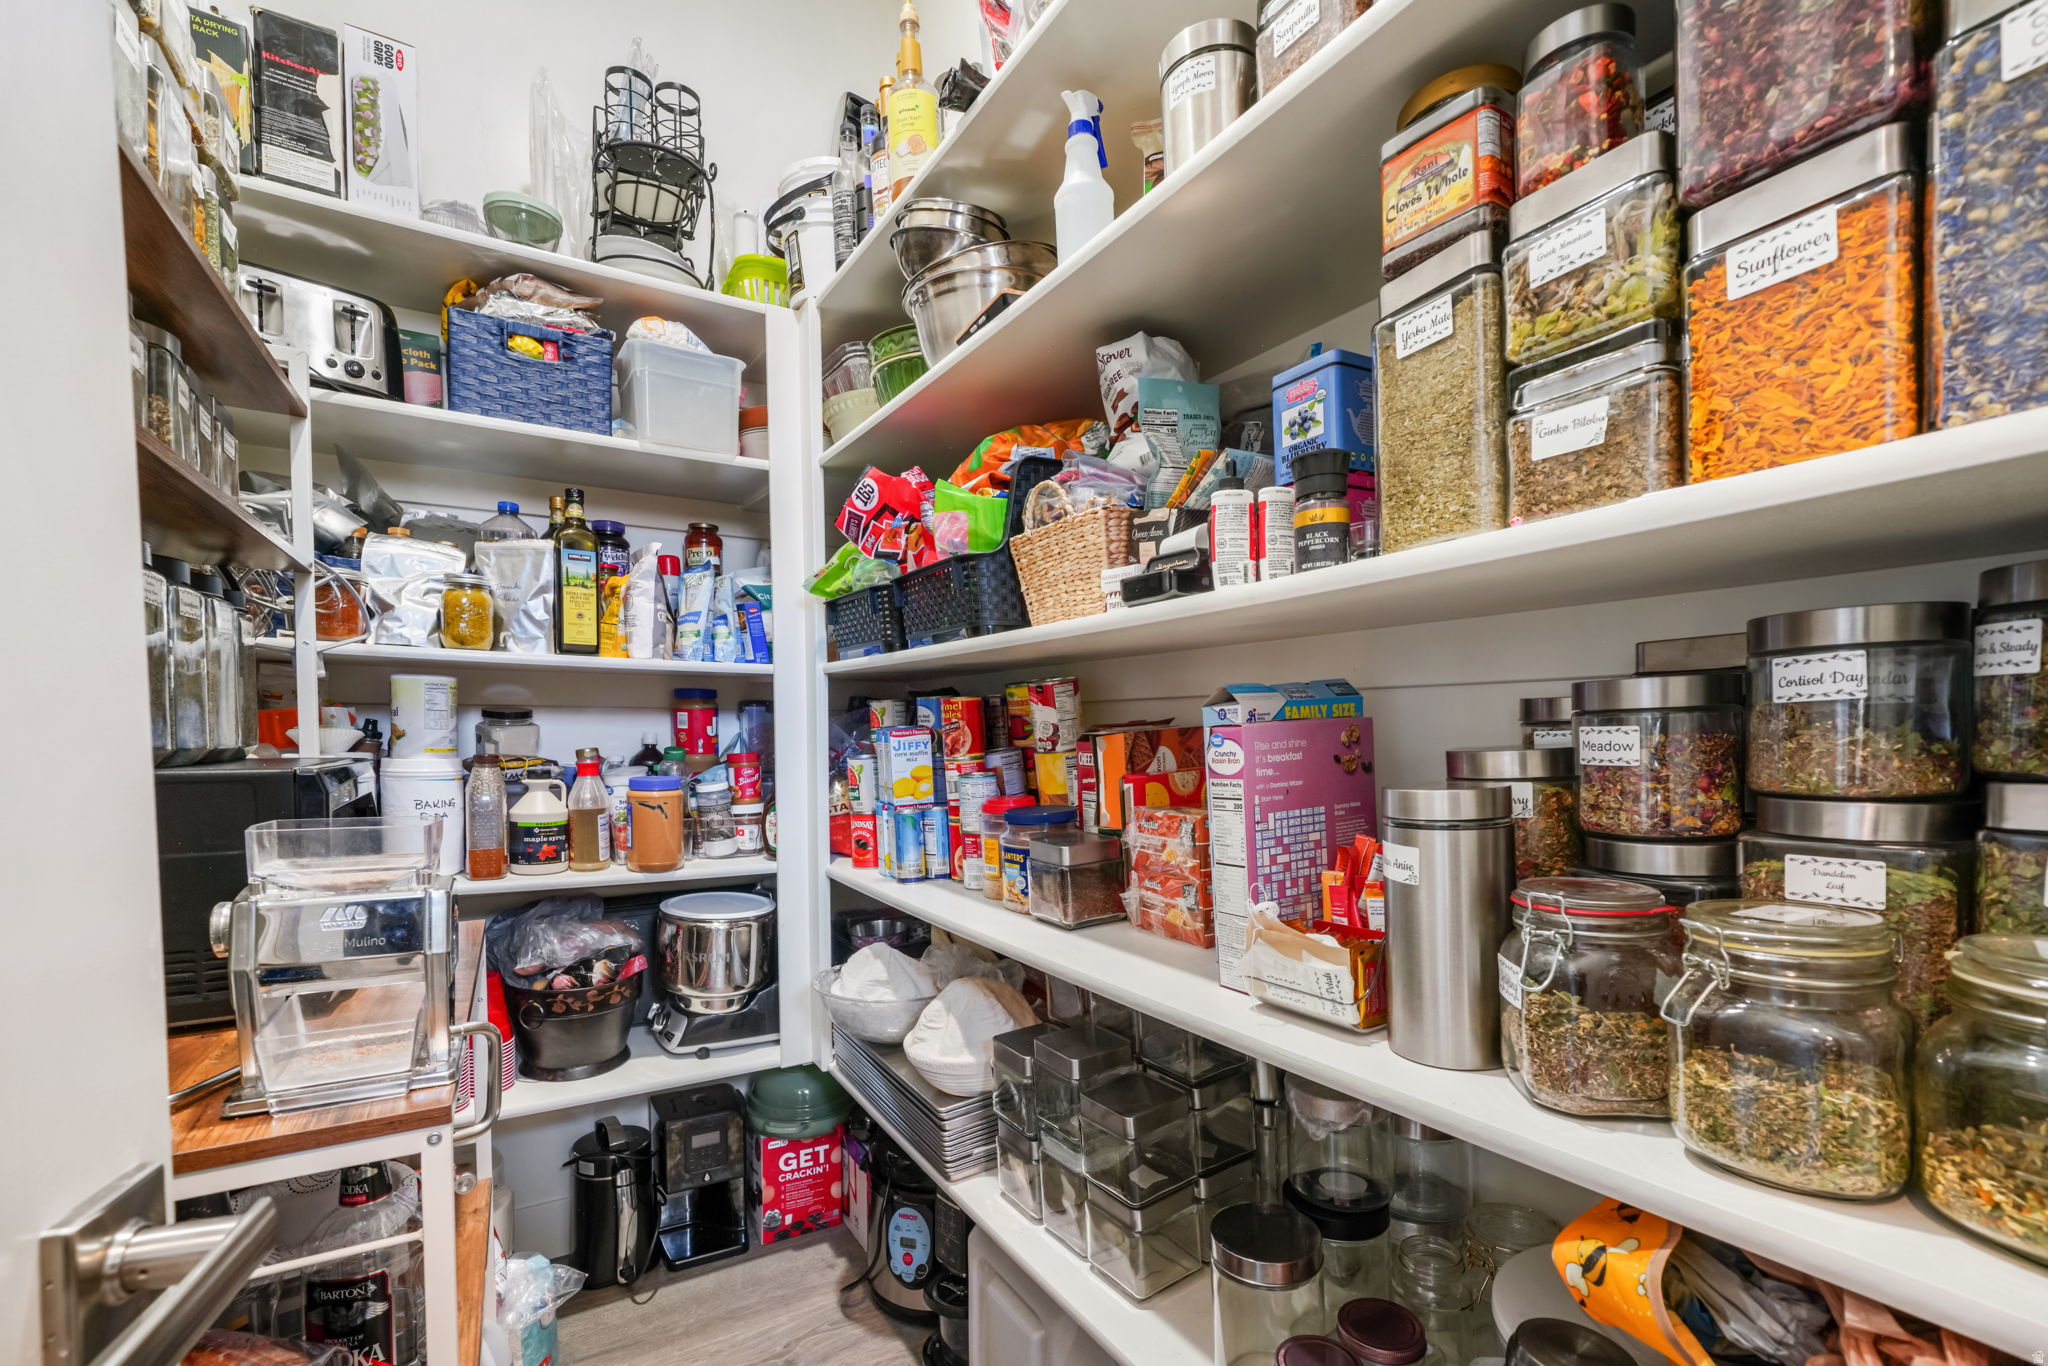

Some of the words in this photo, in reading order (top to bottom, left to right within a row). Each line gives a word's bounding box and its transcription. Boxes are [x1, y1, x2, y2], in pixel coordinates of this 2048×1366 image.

[191, 23, 220, 38] RACK
[202, 18, 239, 36] DRYING
[383, 43, 395, 70] GOOD
[1411, 155, 1439, 179] Rani
[1386, 193, 1423, 224] Cloves
[1426, 166, 1469, 201] Whole
[1558, 229, 1593, 252] Mountain
[1735, 230, 1833, 279] Sunflower
[1401, 325, 1427, 346] Yerba
[1429, 312, 1452, 330] Mate
[409, 357, 437, 371] Pack
[1537, 423, 1570, 440] Ginko
[1288, 436, 1320, 453] ORGANIC
[854, 480, 876, 507] 165
[1297, 536, 1340, 548] PEPPERCORN
[1306, 531, 1329, 539] BLACK
[687, 548, 714, 558] Preo
[1989, 642, 1998, 654] &
[1999, 639, 2039, 657] Steady
[1778, 672, 1825, 689] Cortisol
[1829, 670, 1865, 688] Day
[1284, 703, 1329, 720] FAMILY
[1331, 702, 1357, 717] SIZE
[892, 740, 930, 752] JIFFY
[1254, 741, 1270, 751] Rise
[1271, 740, 1288, 750] and
[1288, 738, 1308, 749] shine
[1582, 740, 1635, 752] Meadow
[1213, 749, 1237, 759] Crunchy
[1267, 751, 1303, 763] breakfast
[738, 773, 760, 786] Biscoff
[413, 798, 456, 810] BAKING
[523, 835, 549, 843] maple
[1393, 857, 1415, 872] Anise
[1812, 867, 1857, 880] Dandelion
[1825, 881, 1846, 894] Leaf
[344, 936, 387, 948] Mulino
[1325, 971, 1335, 996] Petals
[778, 1143, 830, 1172] GET
[778, 1163, 829, 1182] CRACKIN'!
[320, 1285, 366, 1301] BARTON
